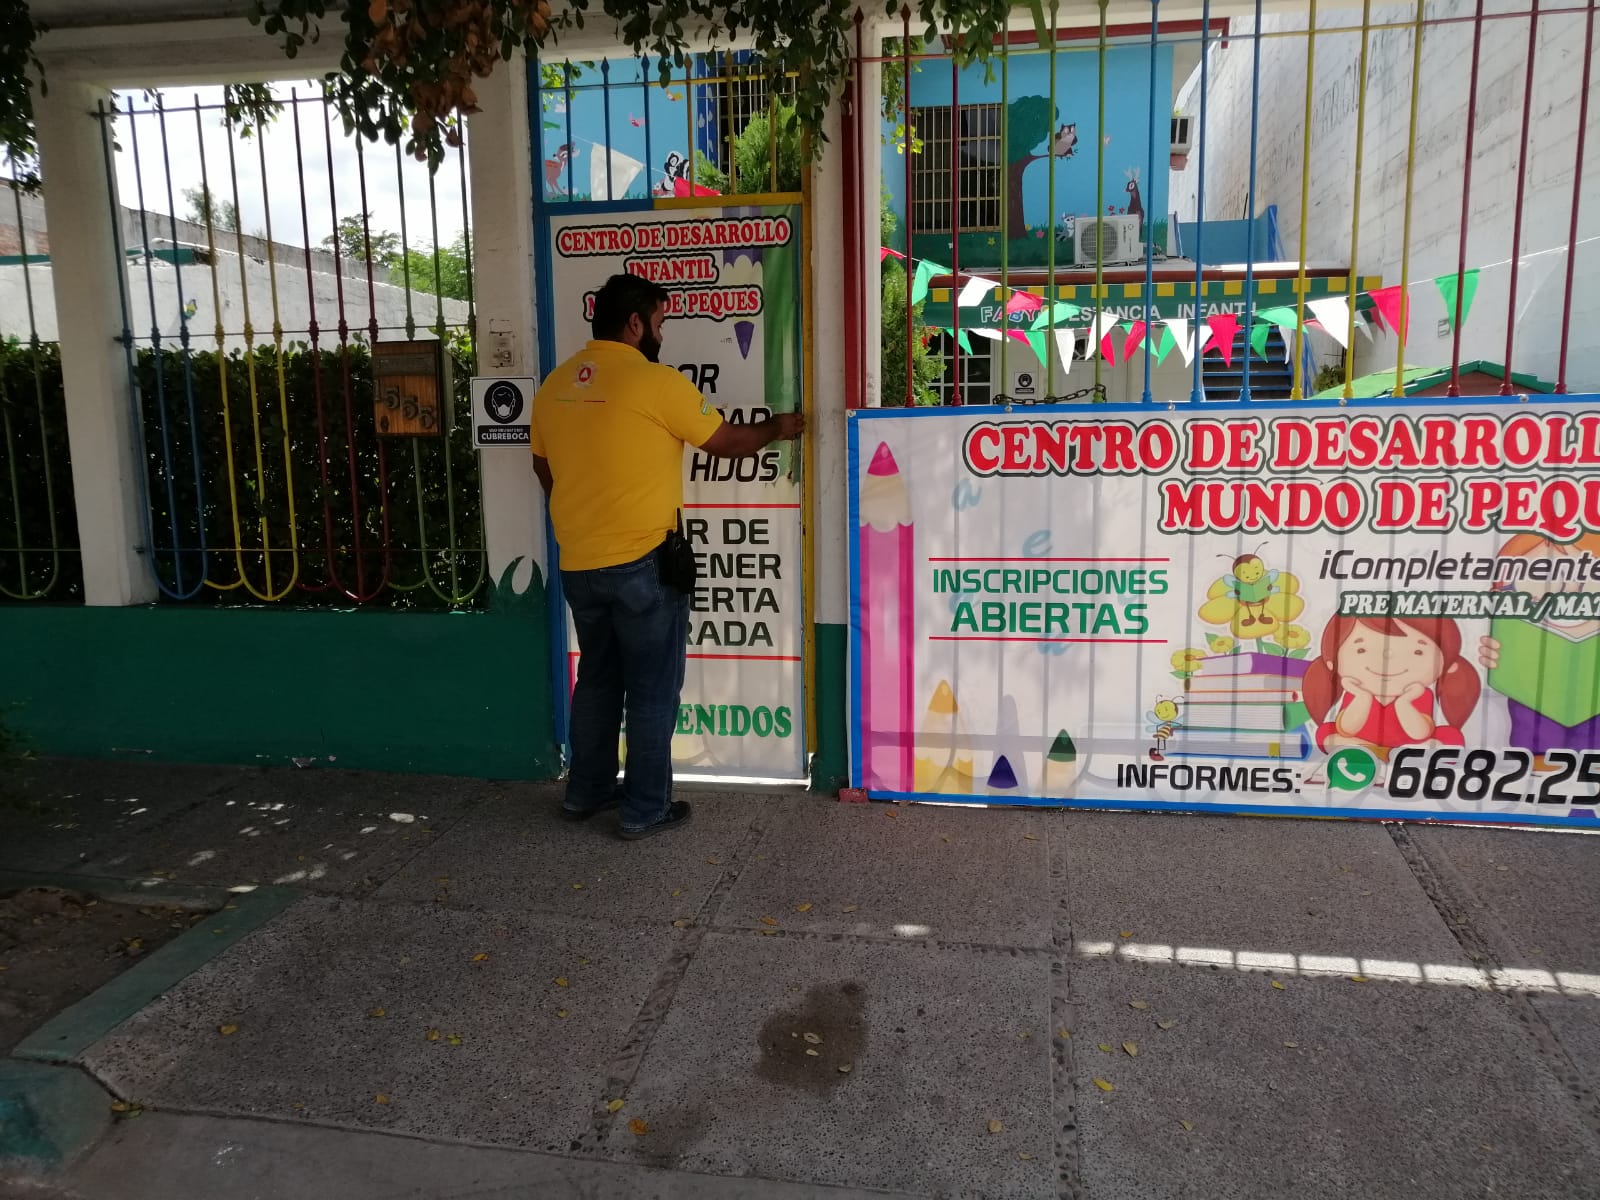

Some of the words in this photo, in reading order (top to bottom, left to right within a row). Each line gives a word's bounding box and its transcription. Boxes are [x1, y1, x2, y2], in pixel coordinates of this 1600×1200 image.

[559, 226, 633, 253] CENTRO
[637, 225, 662, 249] DE
[664, 220, 789, 248] DESARROLLO
[627, 257, 716, 283] INFANTIL
[686, 289, 759, 316] PEQUES
[1177, 301, 1257, 319] INFANTL
[481, 432, 530, 441] CUBREBOCA
[967, 422, 1176, 472] CENTRO
[1188, 421, 1260, 470] DE
[1272, 416, 1600, 468] DESARROLL
[689, 451, 780, 483] HIJOS
[1163, 482, 1361, 529] MUNDO
[1375, 480, 1451, 528] DE
[722, 518, 770, 545] DE
[692, 552, 782, 580] ENER
[932, 568, 1169, 596] INSCRIPCIONES
[689, 586, 781, 614] ERTA
[1341, 594, 1391, 615] PRE
[1395, 593, 1531, 616] MATERNAL
[950, 601, 1150, 635] ABIERTAS
[674, 703, 793, 738] ENIDOS
[1116, 763, 1302, 794] INFORMES:
